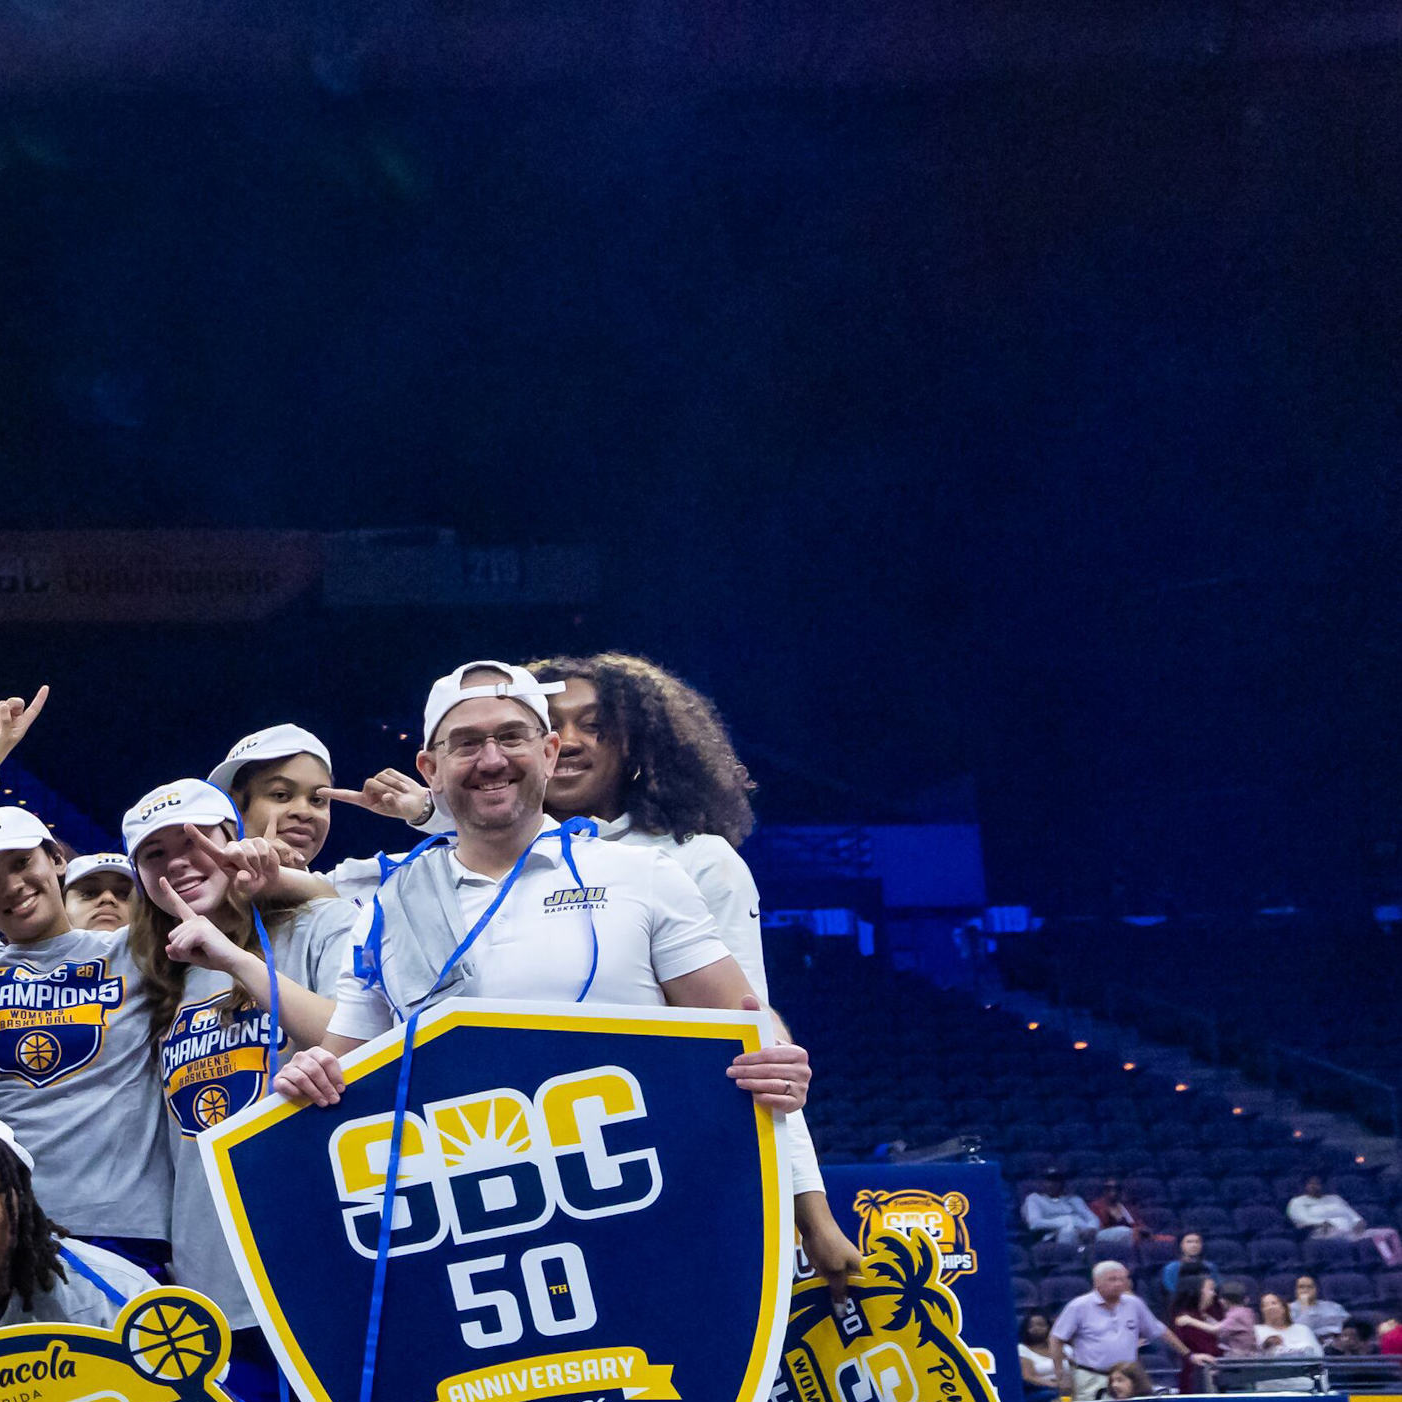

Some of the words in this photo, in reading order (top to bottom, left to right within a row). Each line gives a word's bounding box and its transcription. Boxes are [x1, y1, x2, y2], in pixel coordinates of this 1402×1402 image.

[544, 887, 606, 906] JMU
[162, 1012, 284, 1081] CHAMPIONS
[186, 1053, 230, 1074] WOMEN'S
[328, 1065, 663, 1259] SBC
[446, 1242, 597, 1349] 50
[549, 1284, 569, 1296] TH
